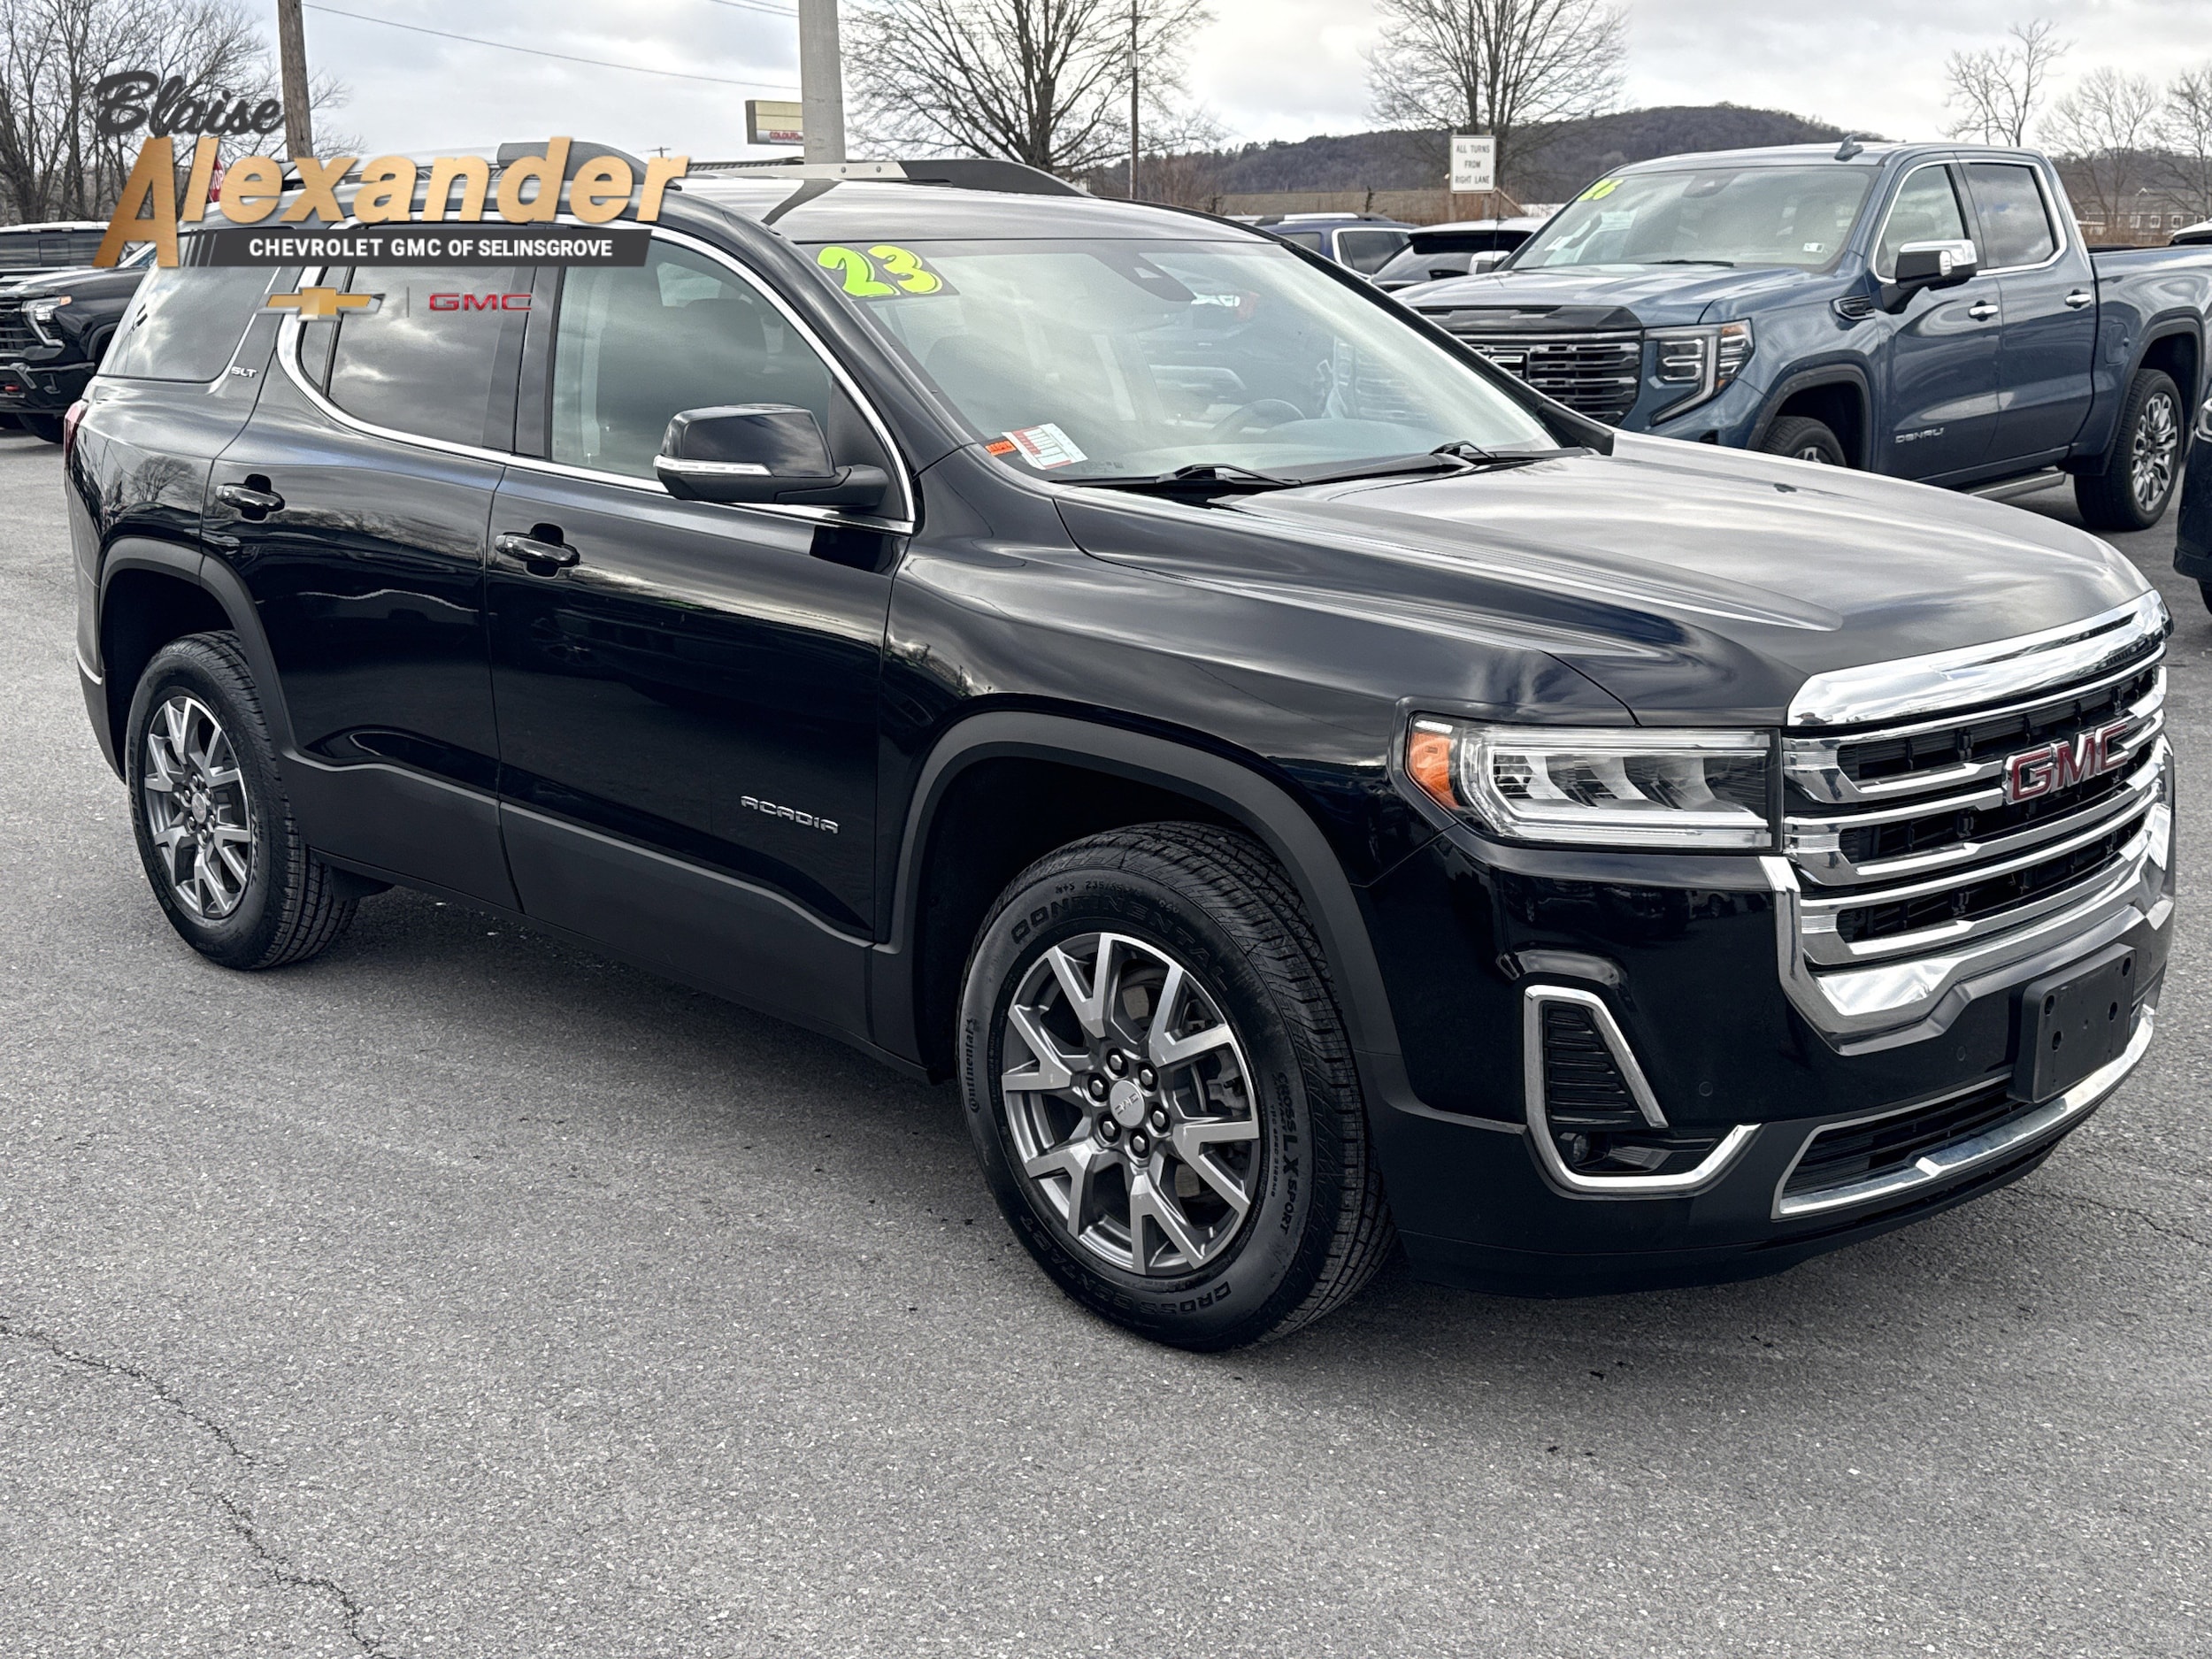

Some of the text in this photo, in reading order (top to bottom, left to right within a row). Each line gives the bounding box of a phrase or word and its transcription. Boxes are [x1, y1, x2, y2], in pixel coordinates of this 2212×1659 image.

[1455, 175, 1490, 184] RIGHT LANE
[1464, 160, 1481, 169] FROM
[817, 243, 943, 298] 23
[231, 365, 257, 378] SLT
[2004, 721, 2130, 805] GMC
[741, 795, 839, 834] ACADIA
[1010, 895, 1228, 993] CONTINENTAL
[1279, 1178, 1297, 1236] SPORT
